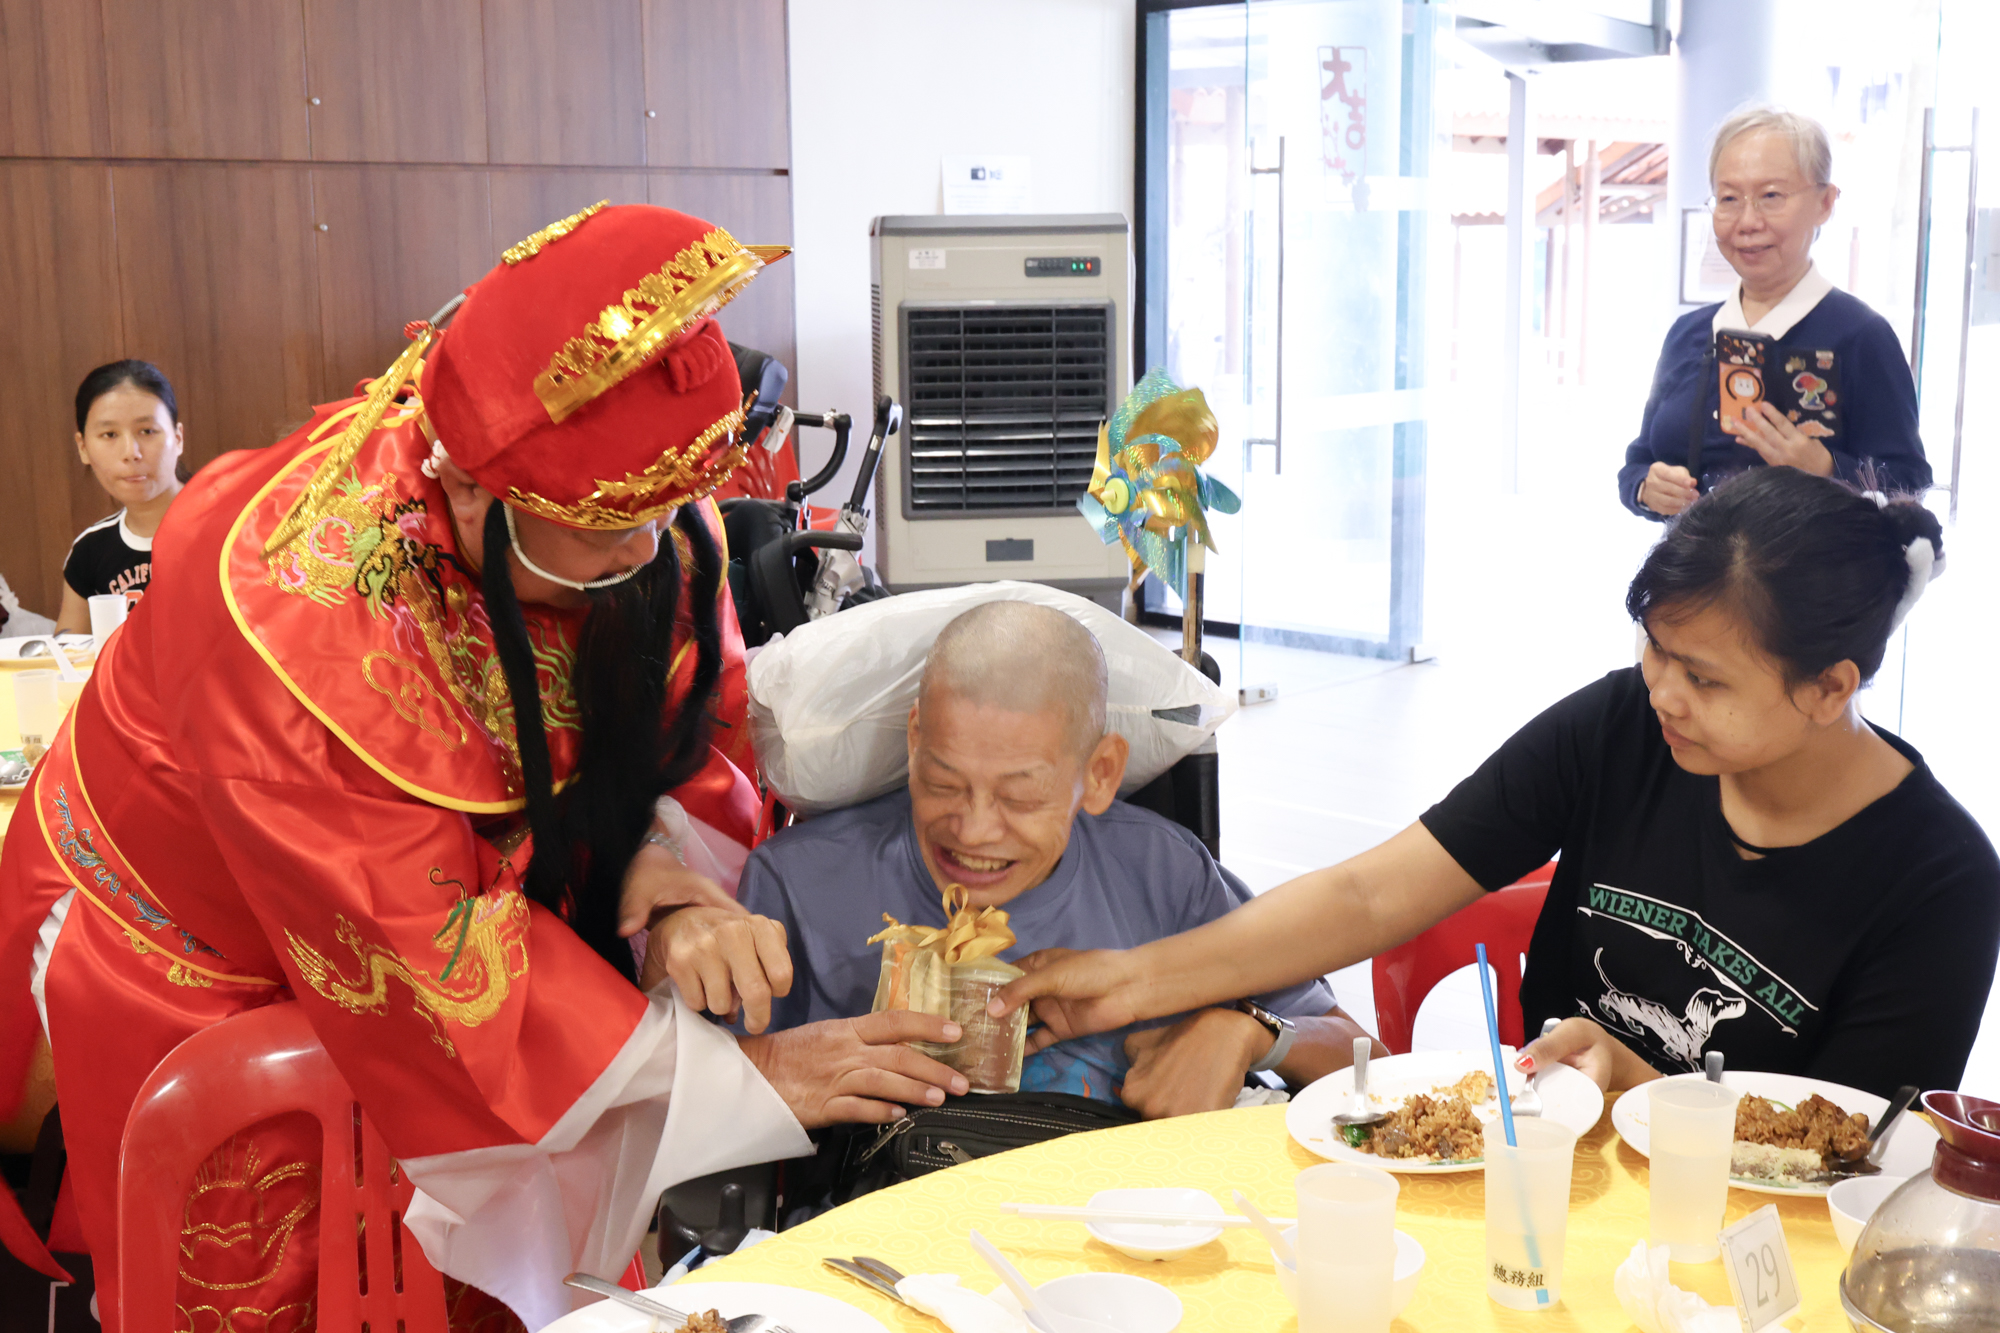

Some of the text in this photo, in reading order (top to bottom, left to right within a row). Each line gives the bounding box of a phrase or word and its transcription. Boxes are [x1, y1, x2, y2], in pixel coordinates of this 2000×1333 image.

[109, 563, 152, 595] CALIF
[1588, 886, 1807, 1027] WIENER TAKES ALL
[1492, 1263, 1545, 1288] 總務組
[1745, 1242, 1781, 1309] 29
